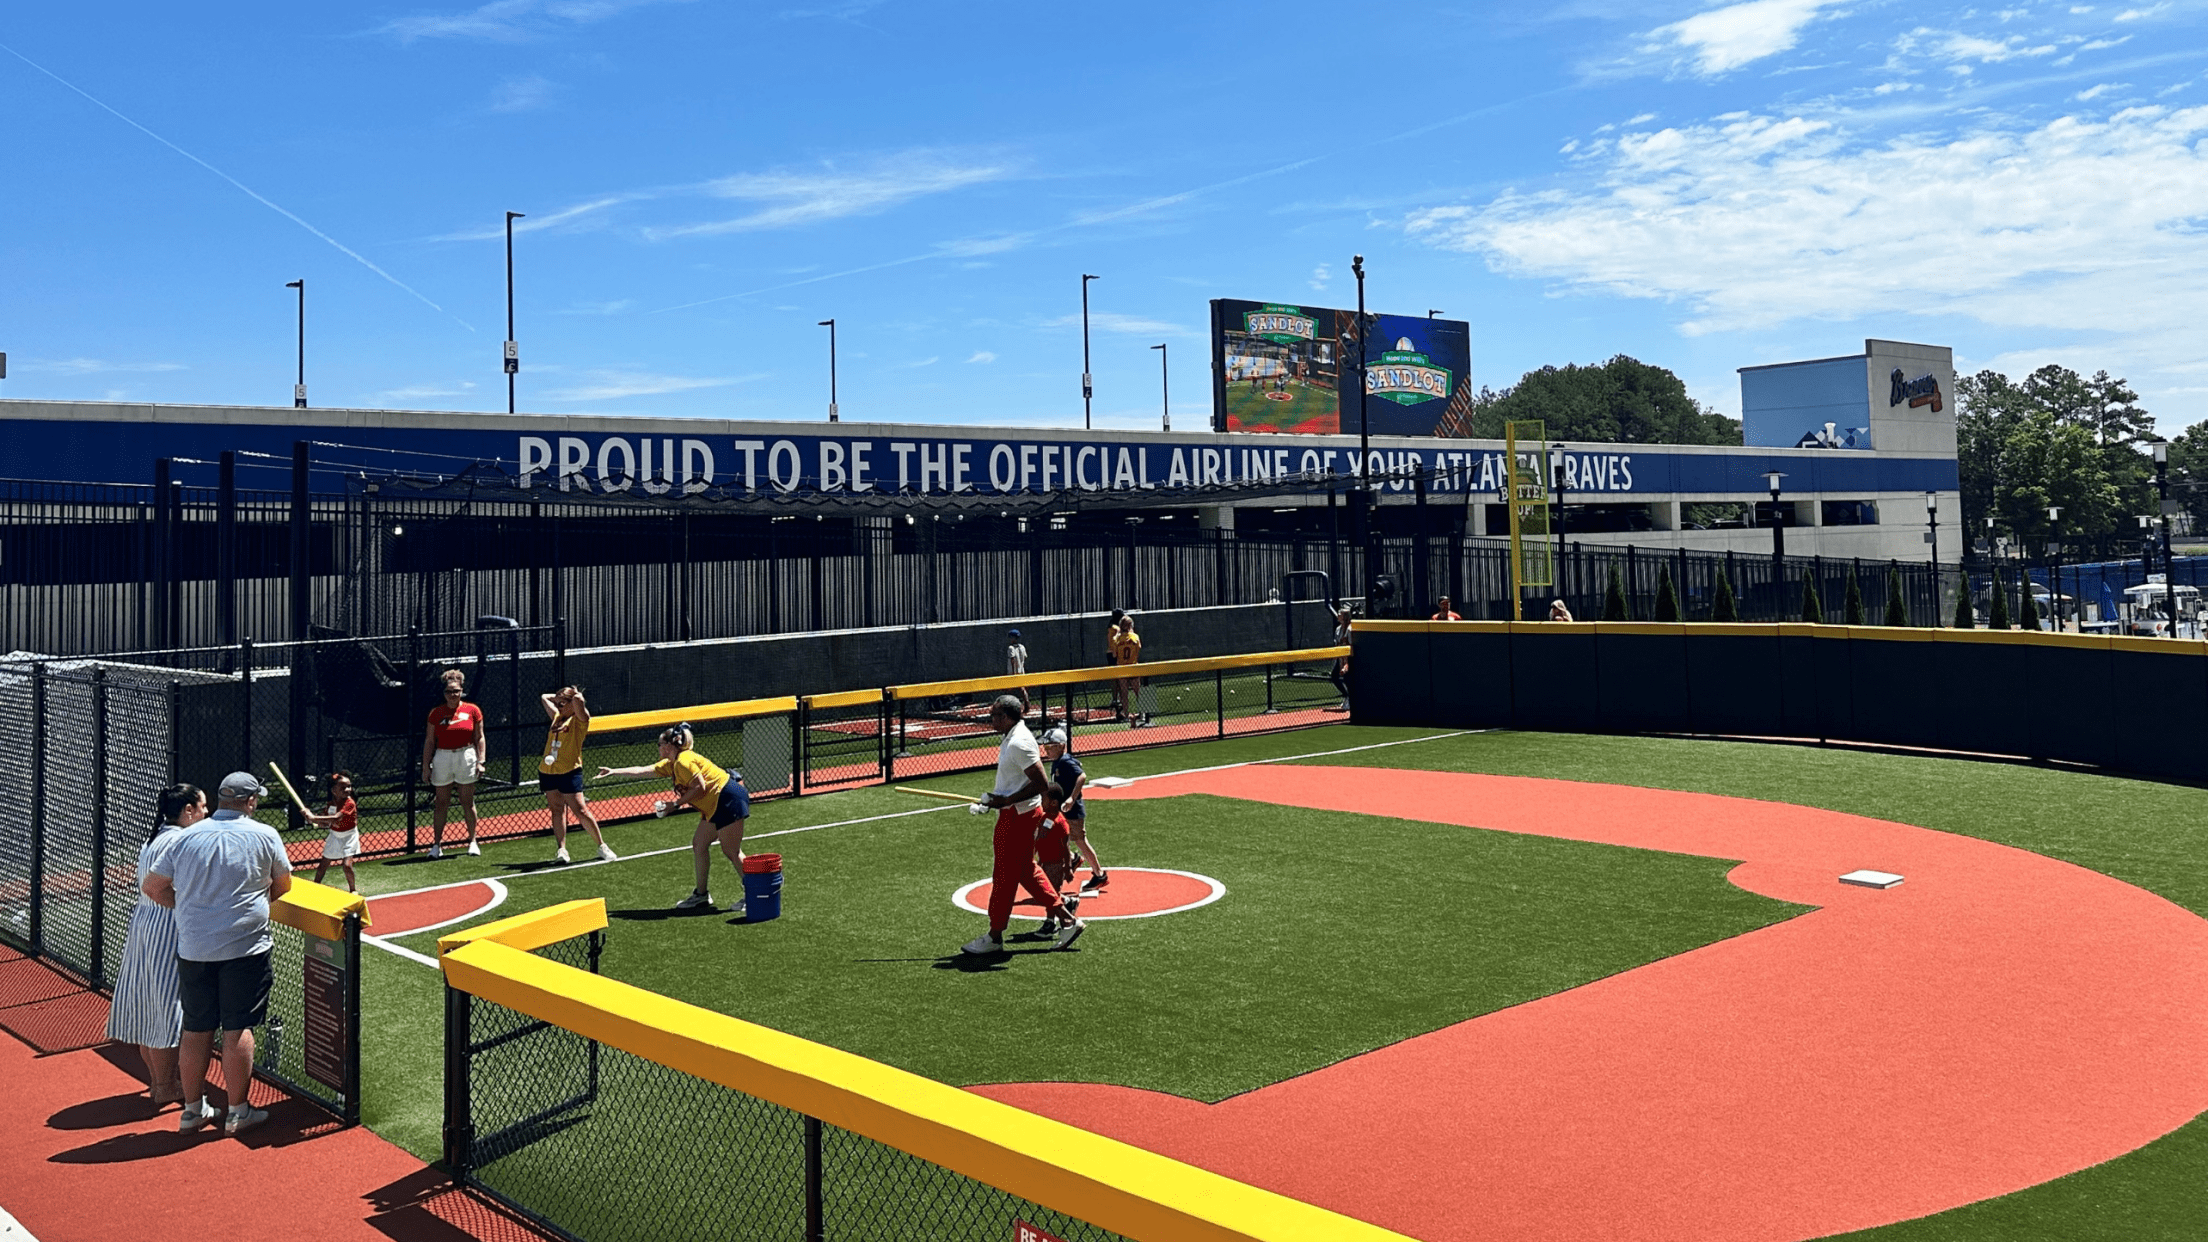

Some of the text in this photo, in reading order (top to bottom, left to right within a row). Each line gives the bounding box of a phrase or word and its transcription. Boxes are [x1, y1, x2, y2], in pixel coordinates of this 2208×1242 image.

[1250, 316, 1313, 336] SANDLOT
[508, 346, 516, 357] 5
[1367, 368, 1446, 393] SANDLOT
[519, 436, 714, 494] PROUD
[735, 440, 801, 493] TO
[820, 441, 873, 492] BE
[891, 442, 972, 492] THE
[989, 444, 1155, 491] OFFICIAL
[1168, 448, 1289, 490] AIRLINE
[1301, 449, 1337, 484] OF
[1346, 450, 1422, 491] YOUR
[1500, 485, 1546, 500] BTTER
